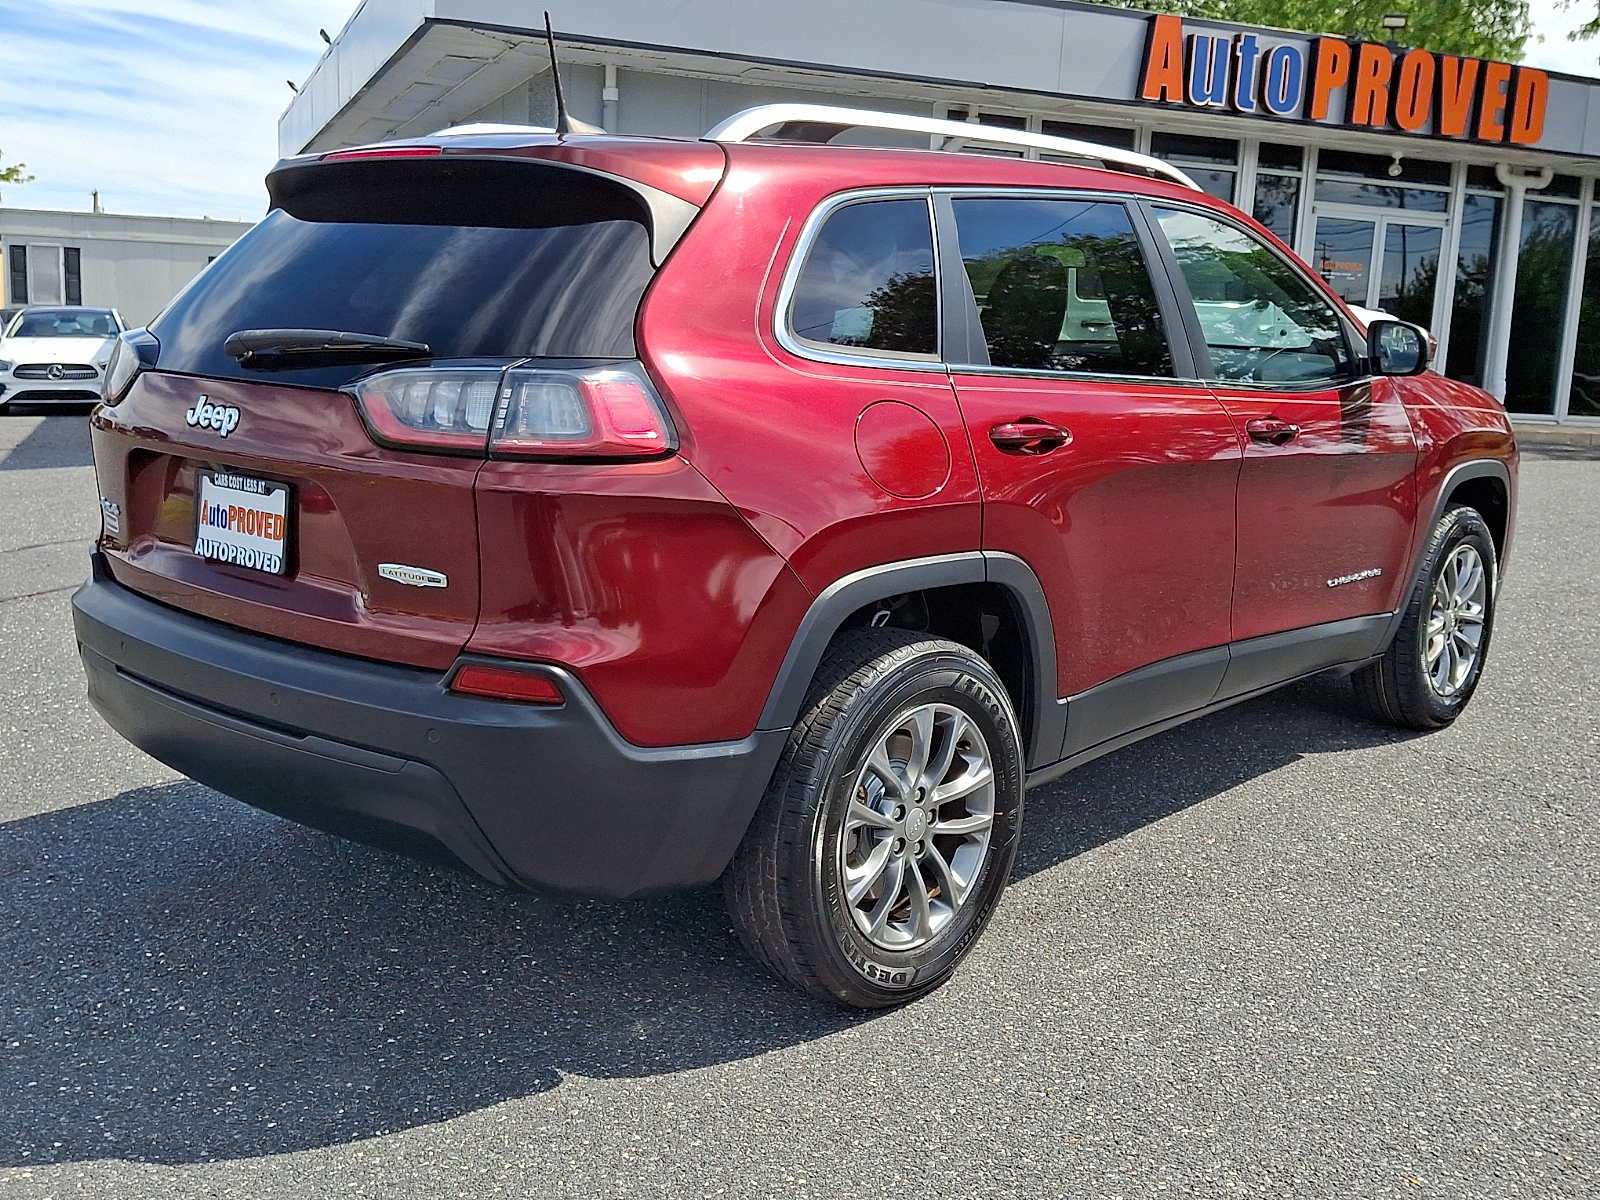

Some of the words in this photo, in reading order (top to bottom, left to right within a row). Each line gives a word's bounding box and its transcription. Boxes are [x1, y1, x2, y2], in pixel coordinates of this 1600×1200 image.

[1141, 14, 1549, 145] AutoPROVED
[187, 394, 240, 438] Jeep
[214, 472, 229, 486] CARS
[229, 475, 244, 490] COST
[243, 478, 258, 493] LESS
[257, 481, 266, 495] AT
[201, 499, 284, 541] AutoPROVED
[194, 537, 281, 574] AUTOPROVED
[382, 568, 427, 581] LATITUDE
